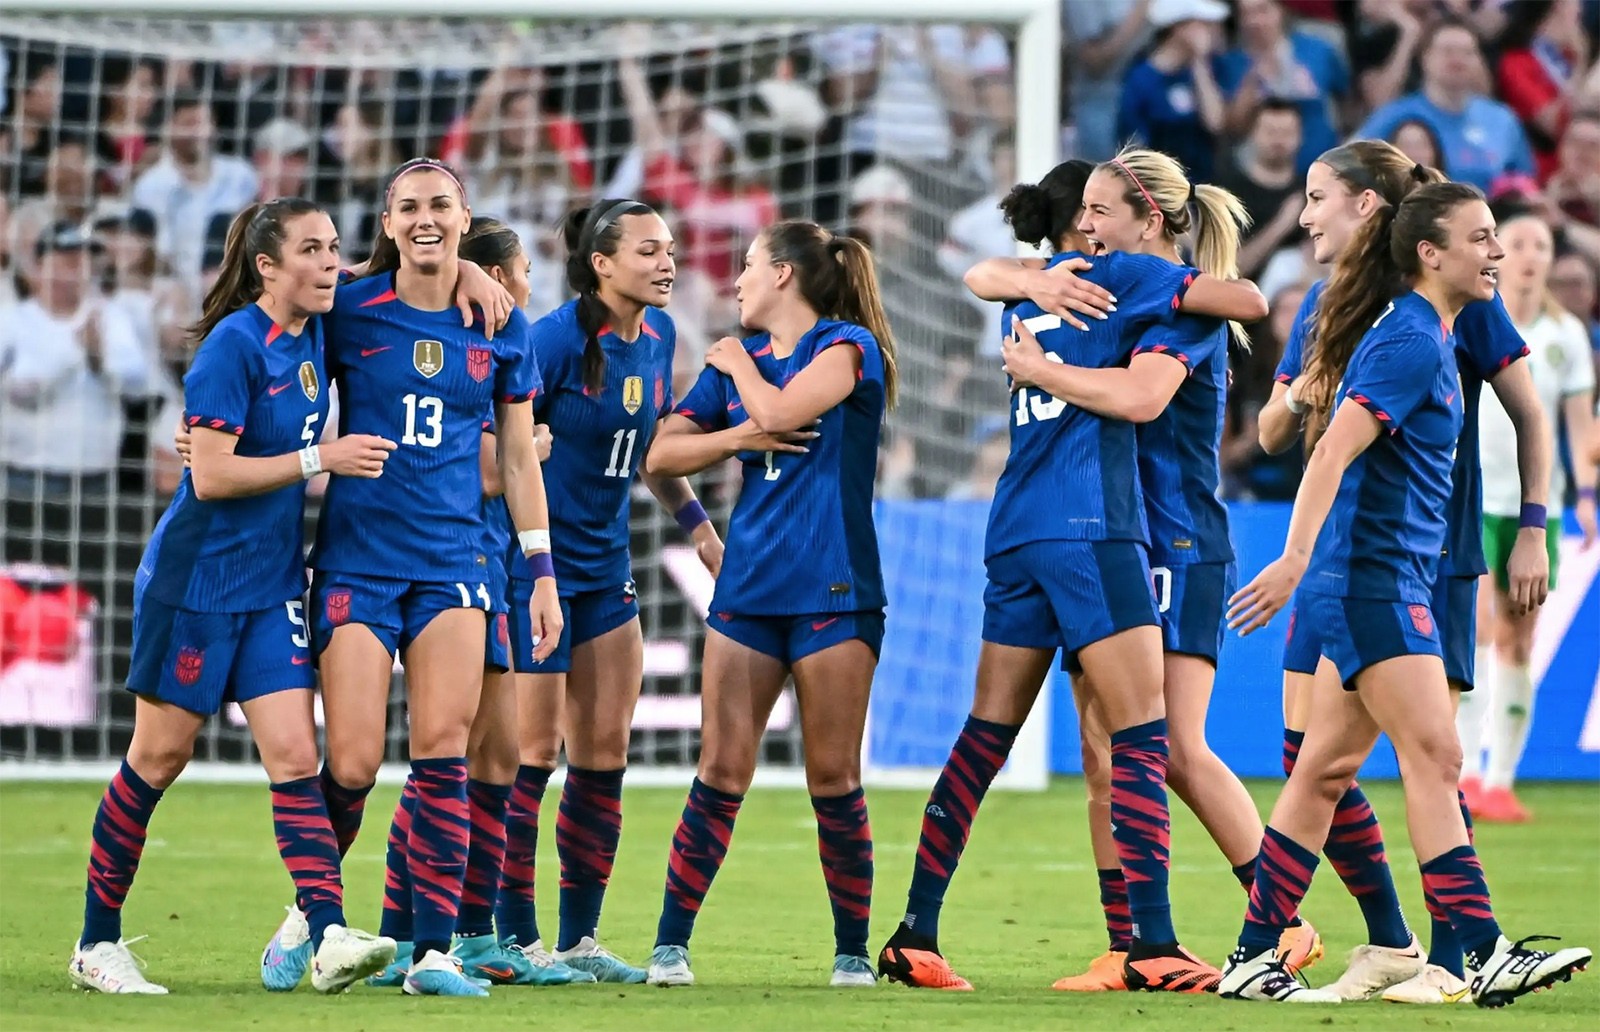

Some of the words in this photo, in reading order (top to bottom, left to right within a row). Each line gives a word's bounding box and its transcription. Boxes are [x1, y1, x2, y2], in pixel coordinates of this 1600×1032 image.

[402, 393, 443, 448] 13
[604, 429, 638, 478] 11
[286, 600, 308, 648] 5
